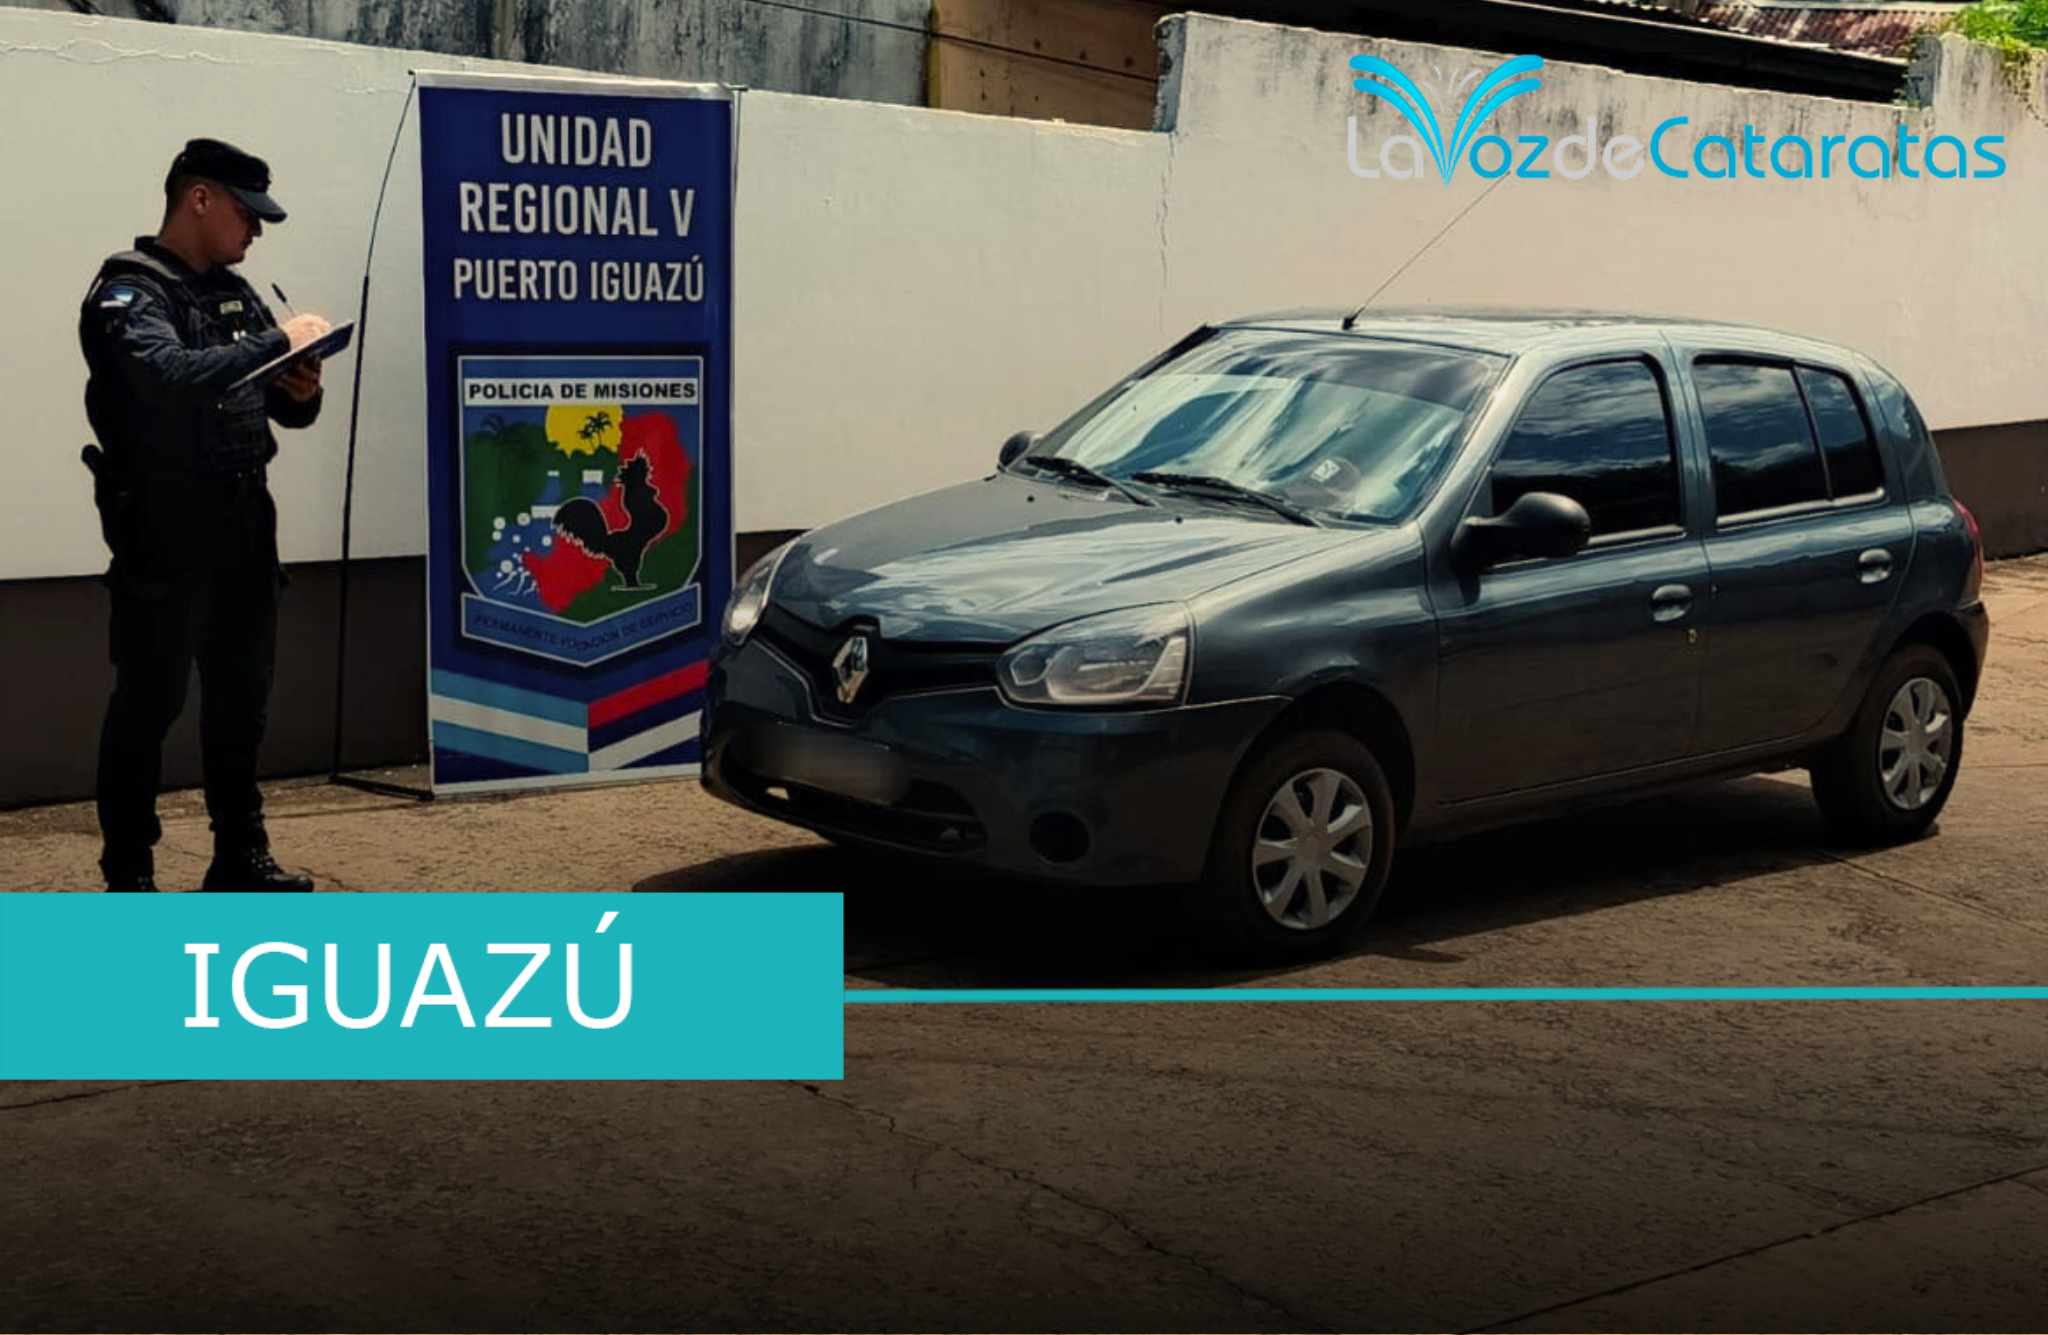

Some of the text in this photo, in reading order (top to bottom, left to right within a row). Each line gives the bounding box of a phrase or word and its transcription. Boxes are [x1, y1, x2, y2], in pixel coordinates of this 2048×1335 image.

[501, 112, 651, 168] UNIDAD
[459, 182, 695, 237] REGIONAL V
[453, 255, 704, 302] PUERTO IGUAZÚ
[468, 382, 697, 400] POLICIA DE MISIONES
